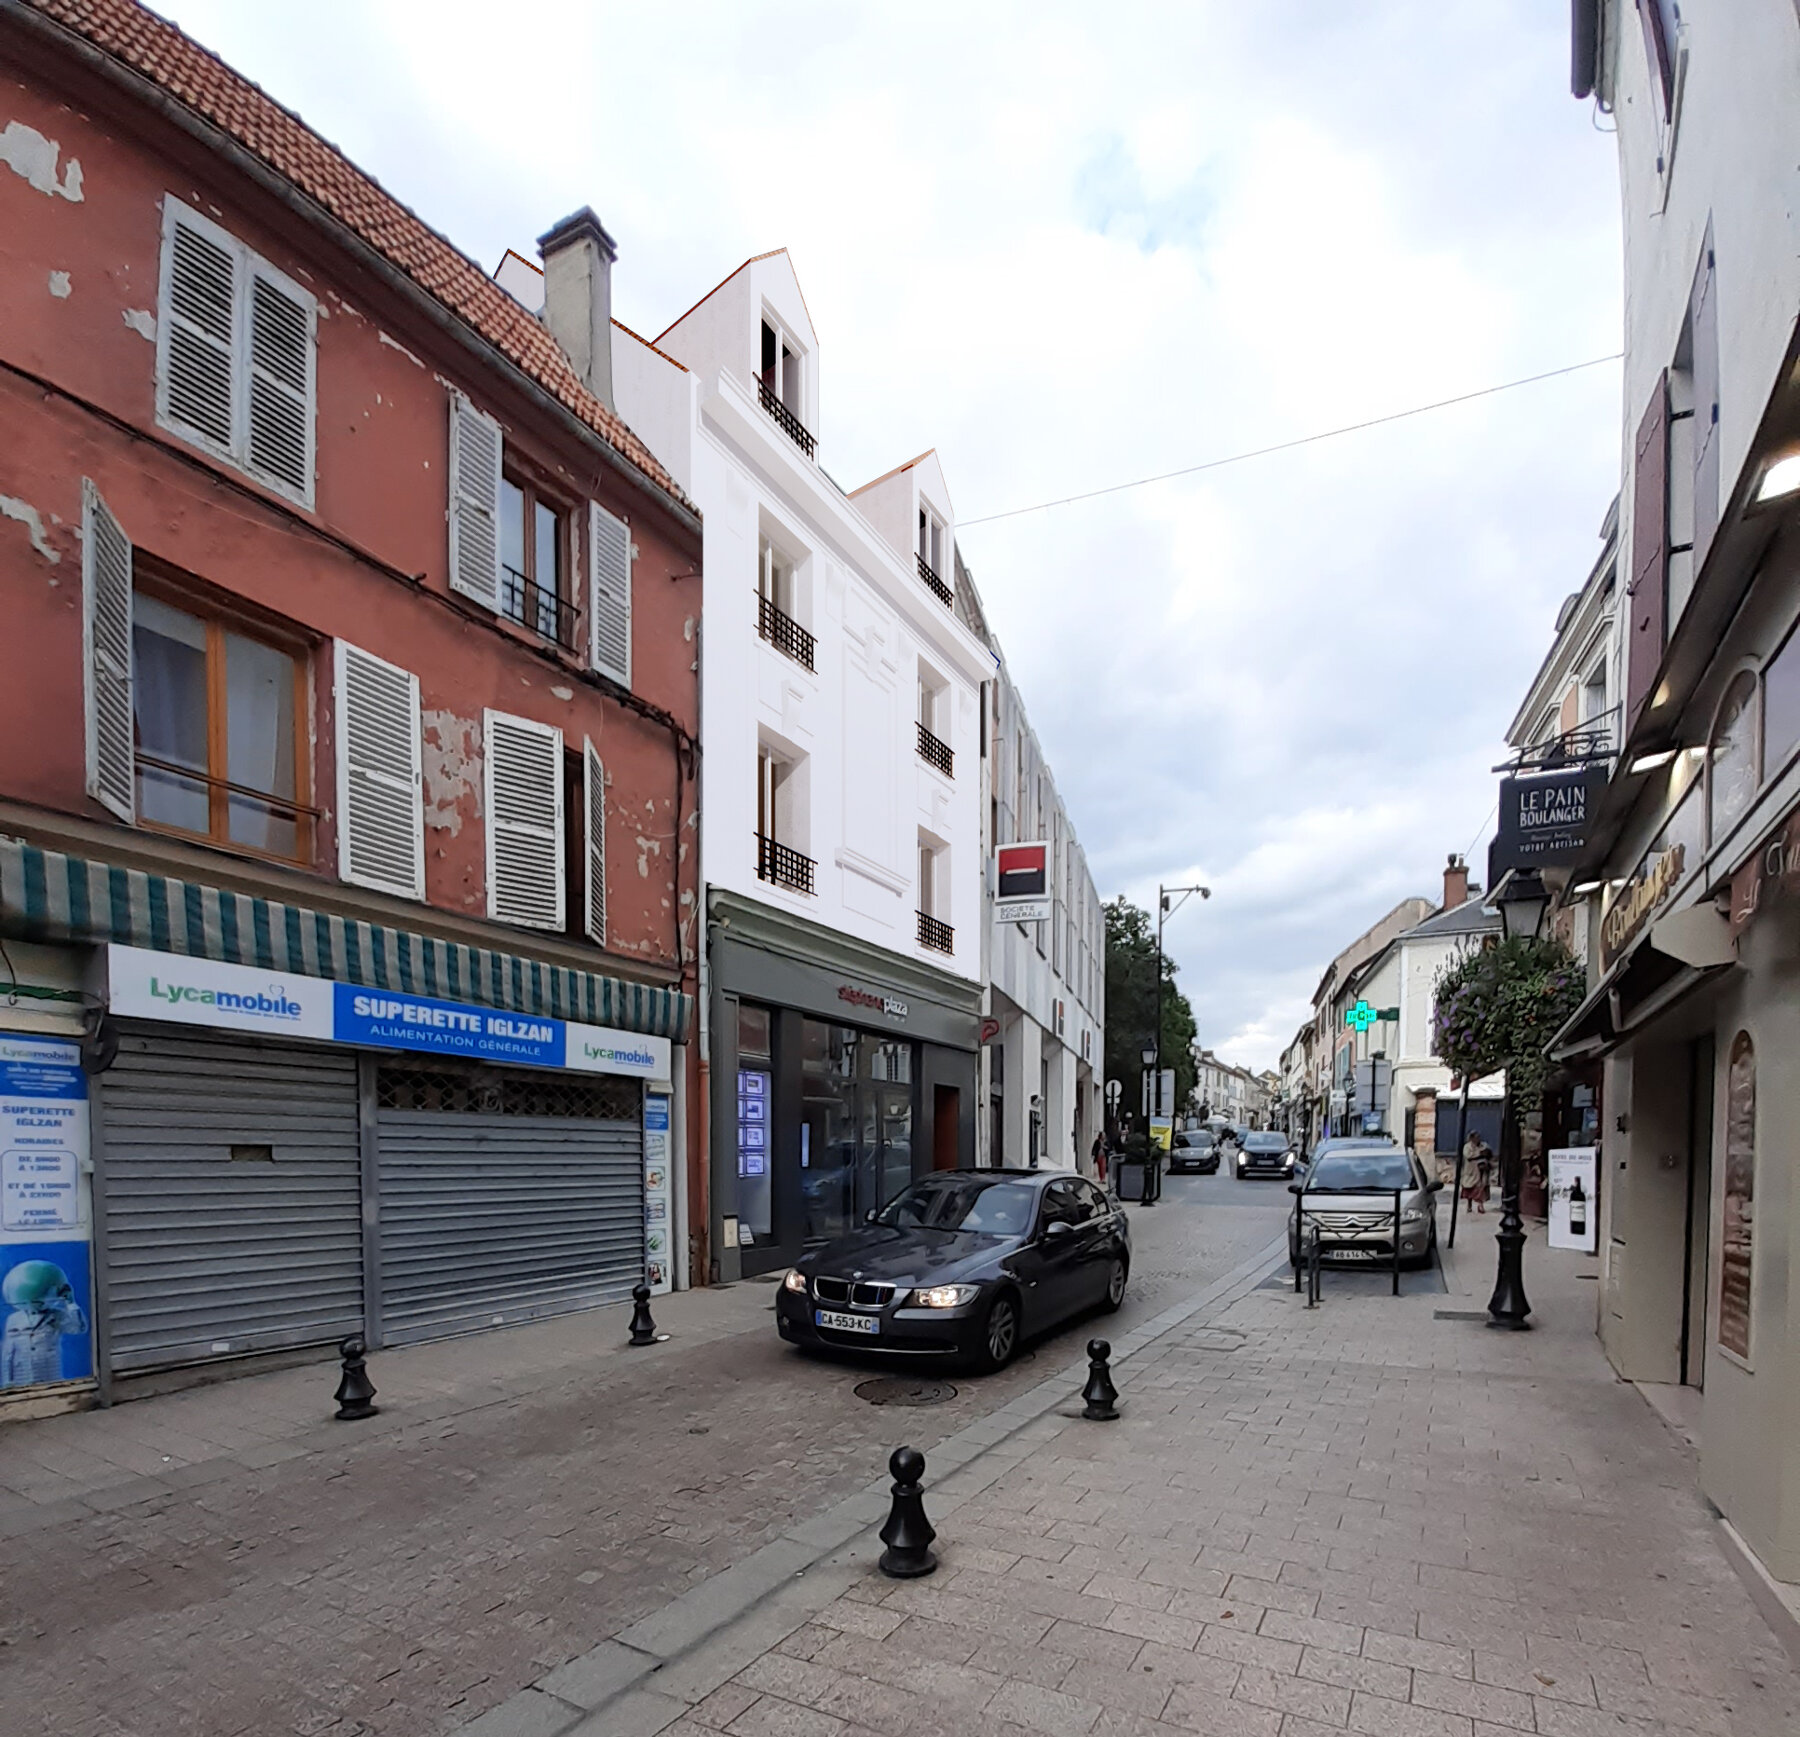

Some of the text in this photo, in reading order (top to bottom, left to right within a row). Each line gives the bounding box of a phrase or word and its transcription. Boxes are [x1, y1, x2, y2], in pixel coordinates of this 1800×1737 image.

[1520, 786, 1585, 811] LE PAIN
[1520, 806, 1585, 828] BOULANGER
[151, 976, 302, 1016] Lycamobile
[353, 995, 554, 1044] SUPERETTE IGLZAN
[370, 1024, 474, 1048] ALIMENTATION
[2, 1046, 76, 1061] Lycamobile
[584, 1042, 655, 1065] Lycamobile
[2, 1105, 76, 1117] SUPERETTE
[16, 1117, 63, 1128] IGLZAN
